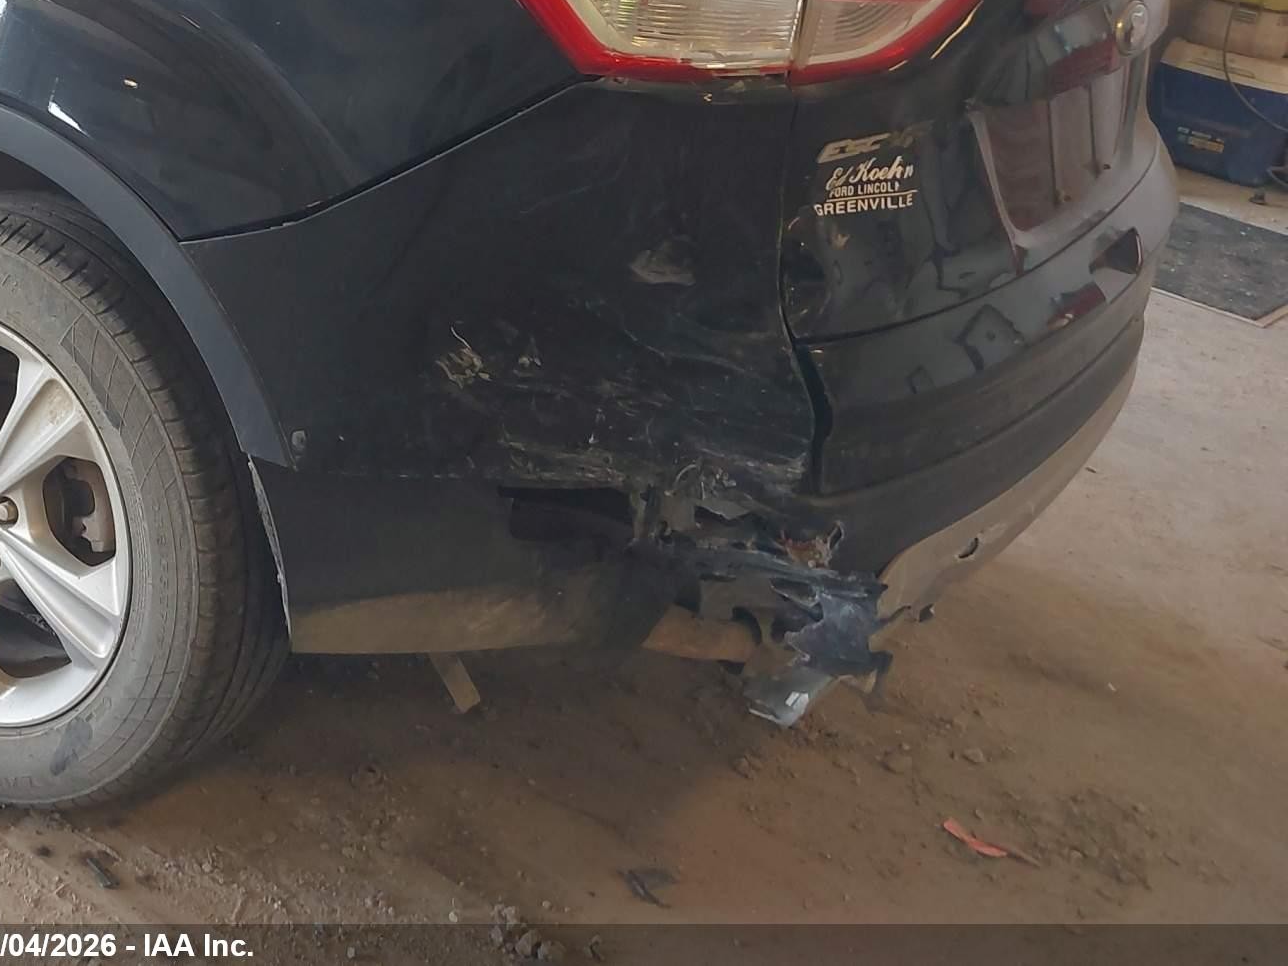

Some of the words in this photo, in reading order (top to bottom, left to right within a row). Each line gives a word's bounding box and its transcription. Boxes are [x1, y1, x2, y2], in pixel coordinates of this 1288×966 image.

[826, 166, 854, 190] Ed
[849, 155, 914, 183] Koehn
[814, 194, 913, 216] GREENVILLE
